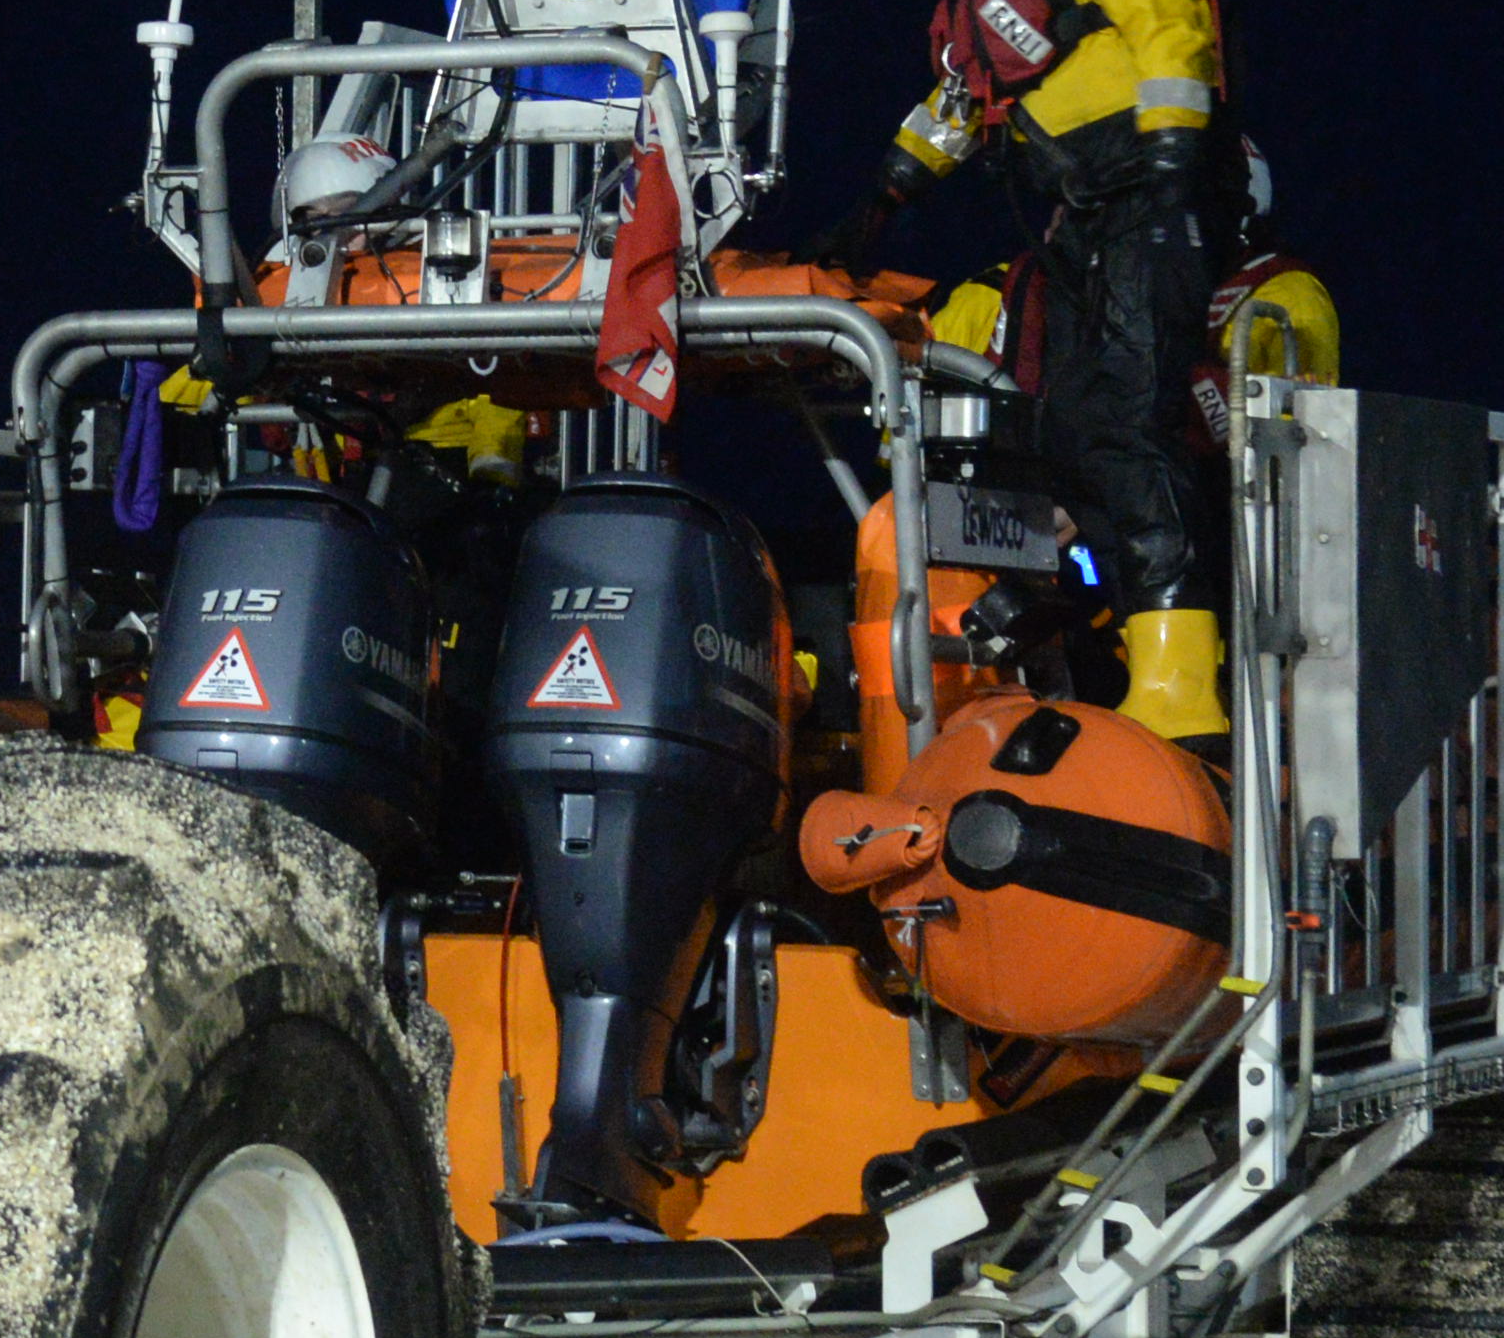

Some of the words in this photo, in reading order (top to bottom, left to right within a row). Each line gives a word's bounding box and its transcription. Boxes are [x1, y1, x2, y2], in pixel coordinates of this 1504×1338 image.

[988, 6, 1042, 57] RNLI
[201, 588, 282, 613] 115
[550, 586, 633, 611] 115
